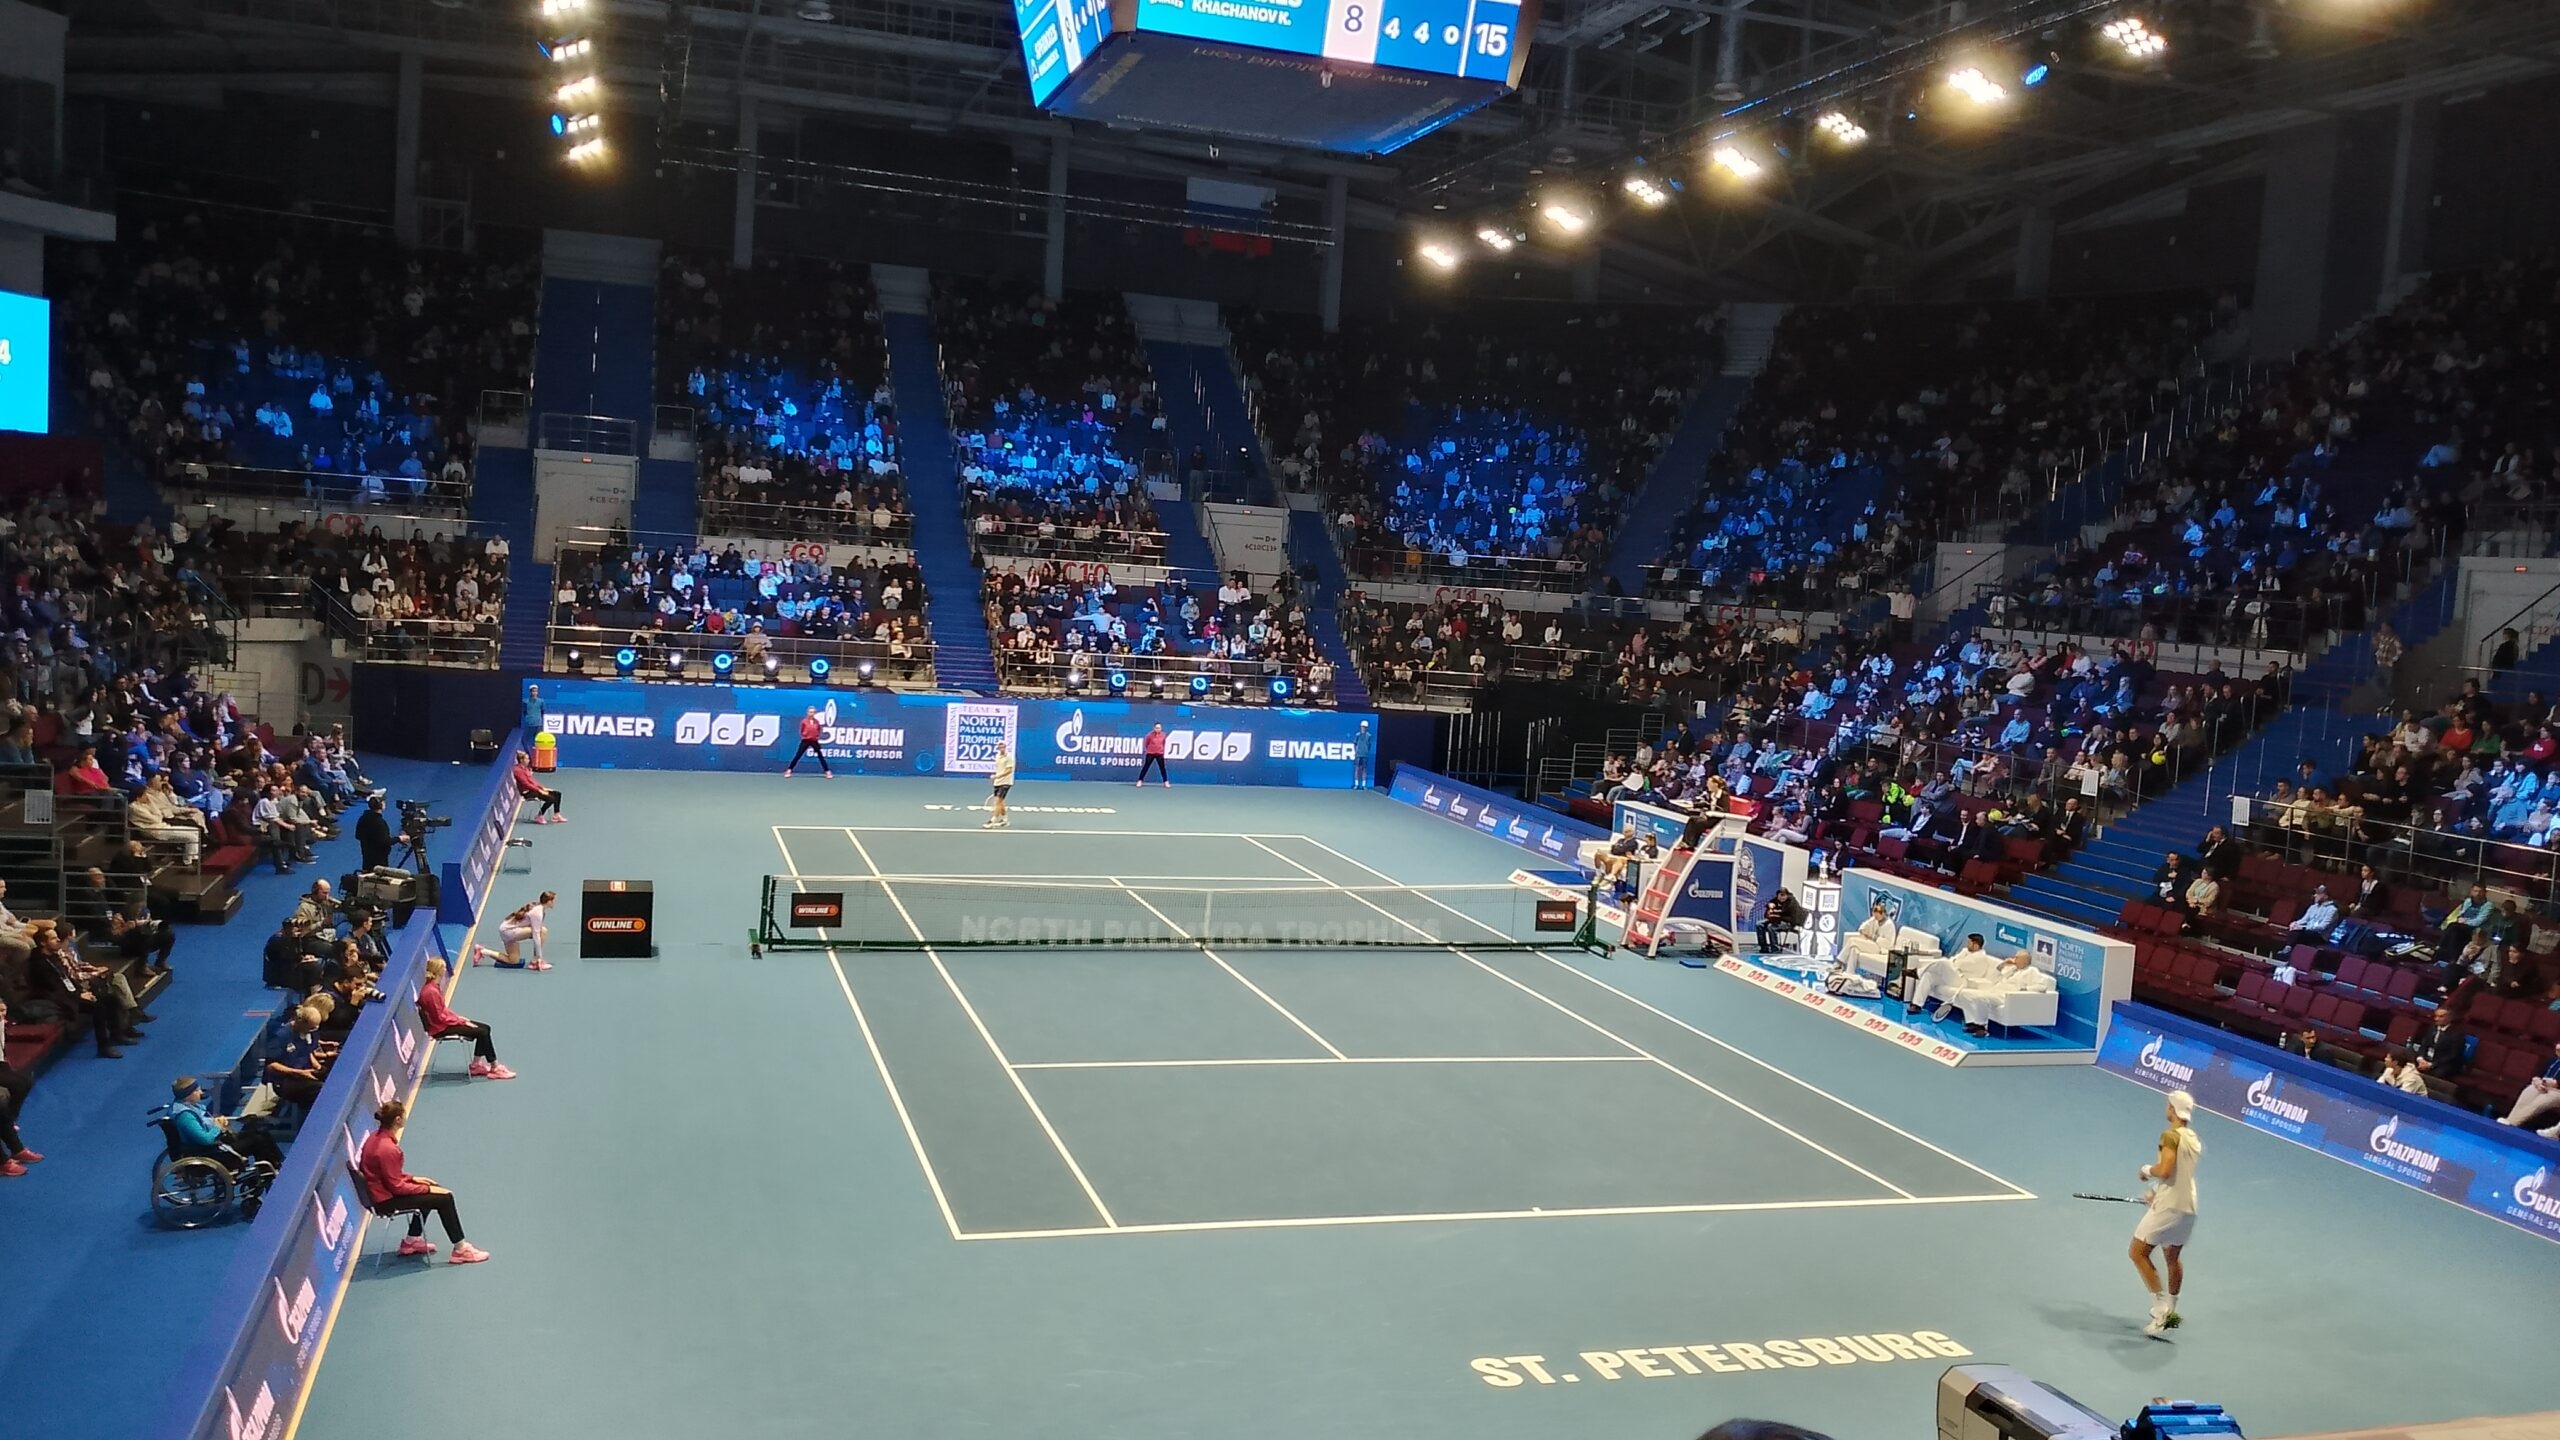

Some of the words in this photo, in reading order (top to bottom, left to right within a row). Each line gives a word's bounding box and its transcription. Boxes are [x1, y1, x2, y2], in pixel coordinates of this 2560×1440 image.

[1192, 0, 1278, 24] KHACHANOV
[1278, 11, 1292, 26] K.
[1344, 5, 1364, 32] 8
[1384, 18, 1400, 39] 4
[1414, 22, 1430, 44] 4
[1444, 26, 1460, 45] 0
[1475, 23, 1508, 56] 15
[302, 662, 326, 706] D
[567, 715, 655, 737] MAER
[960, 716, 1005, 726] NORTH
[960, 726, 1004, 734] PALMYRA
[835, 727, 904, 746] GAZPROM
[1081, 736, 1143, 754] GAZPROM
[806, 748, 852, 758] GNERAL
[856, 750, 903, 759] SPONSOR
[958, 744, 1000, 760] 2025
[1288, 740, 1356, 760] MAER
[1056, 756, 1097, 765] GENERAL
[1101, 758, 1142, 767] SPONSOR
[592, 920, 633, 929] WINLINE
[961, 915, 1092, 945] NORTH
[2057, 963, 2082, 981] 2025
[2134, 1067, 2160, 1082] GENERAL
[2153, 1055, 2194, 1082] GAZPROM
[2241, 1106, 2270, 1124] GENERAL
[2262, 1095, 2309, 1124] GAZPROM
[2386, 1141, 2440, 1173] GAZPROM
[2363, 1152, 2395, 1170] GENERAL
[2397, 1164, 2433, 1184] SPONSOR
[2506, 1205, 2545, 1226] GENERAL
[1470, 1355, 1581, 1388] ST.
[1579, 1330, 1974, 1381] PETERSBURG
